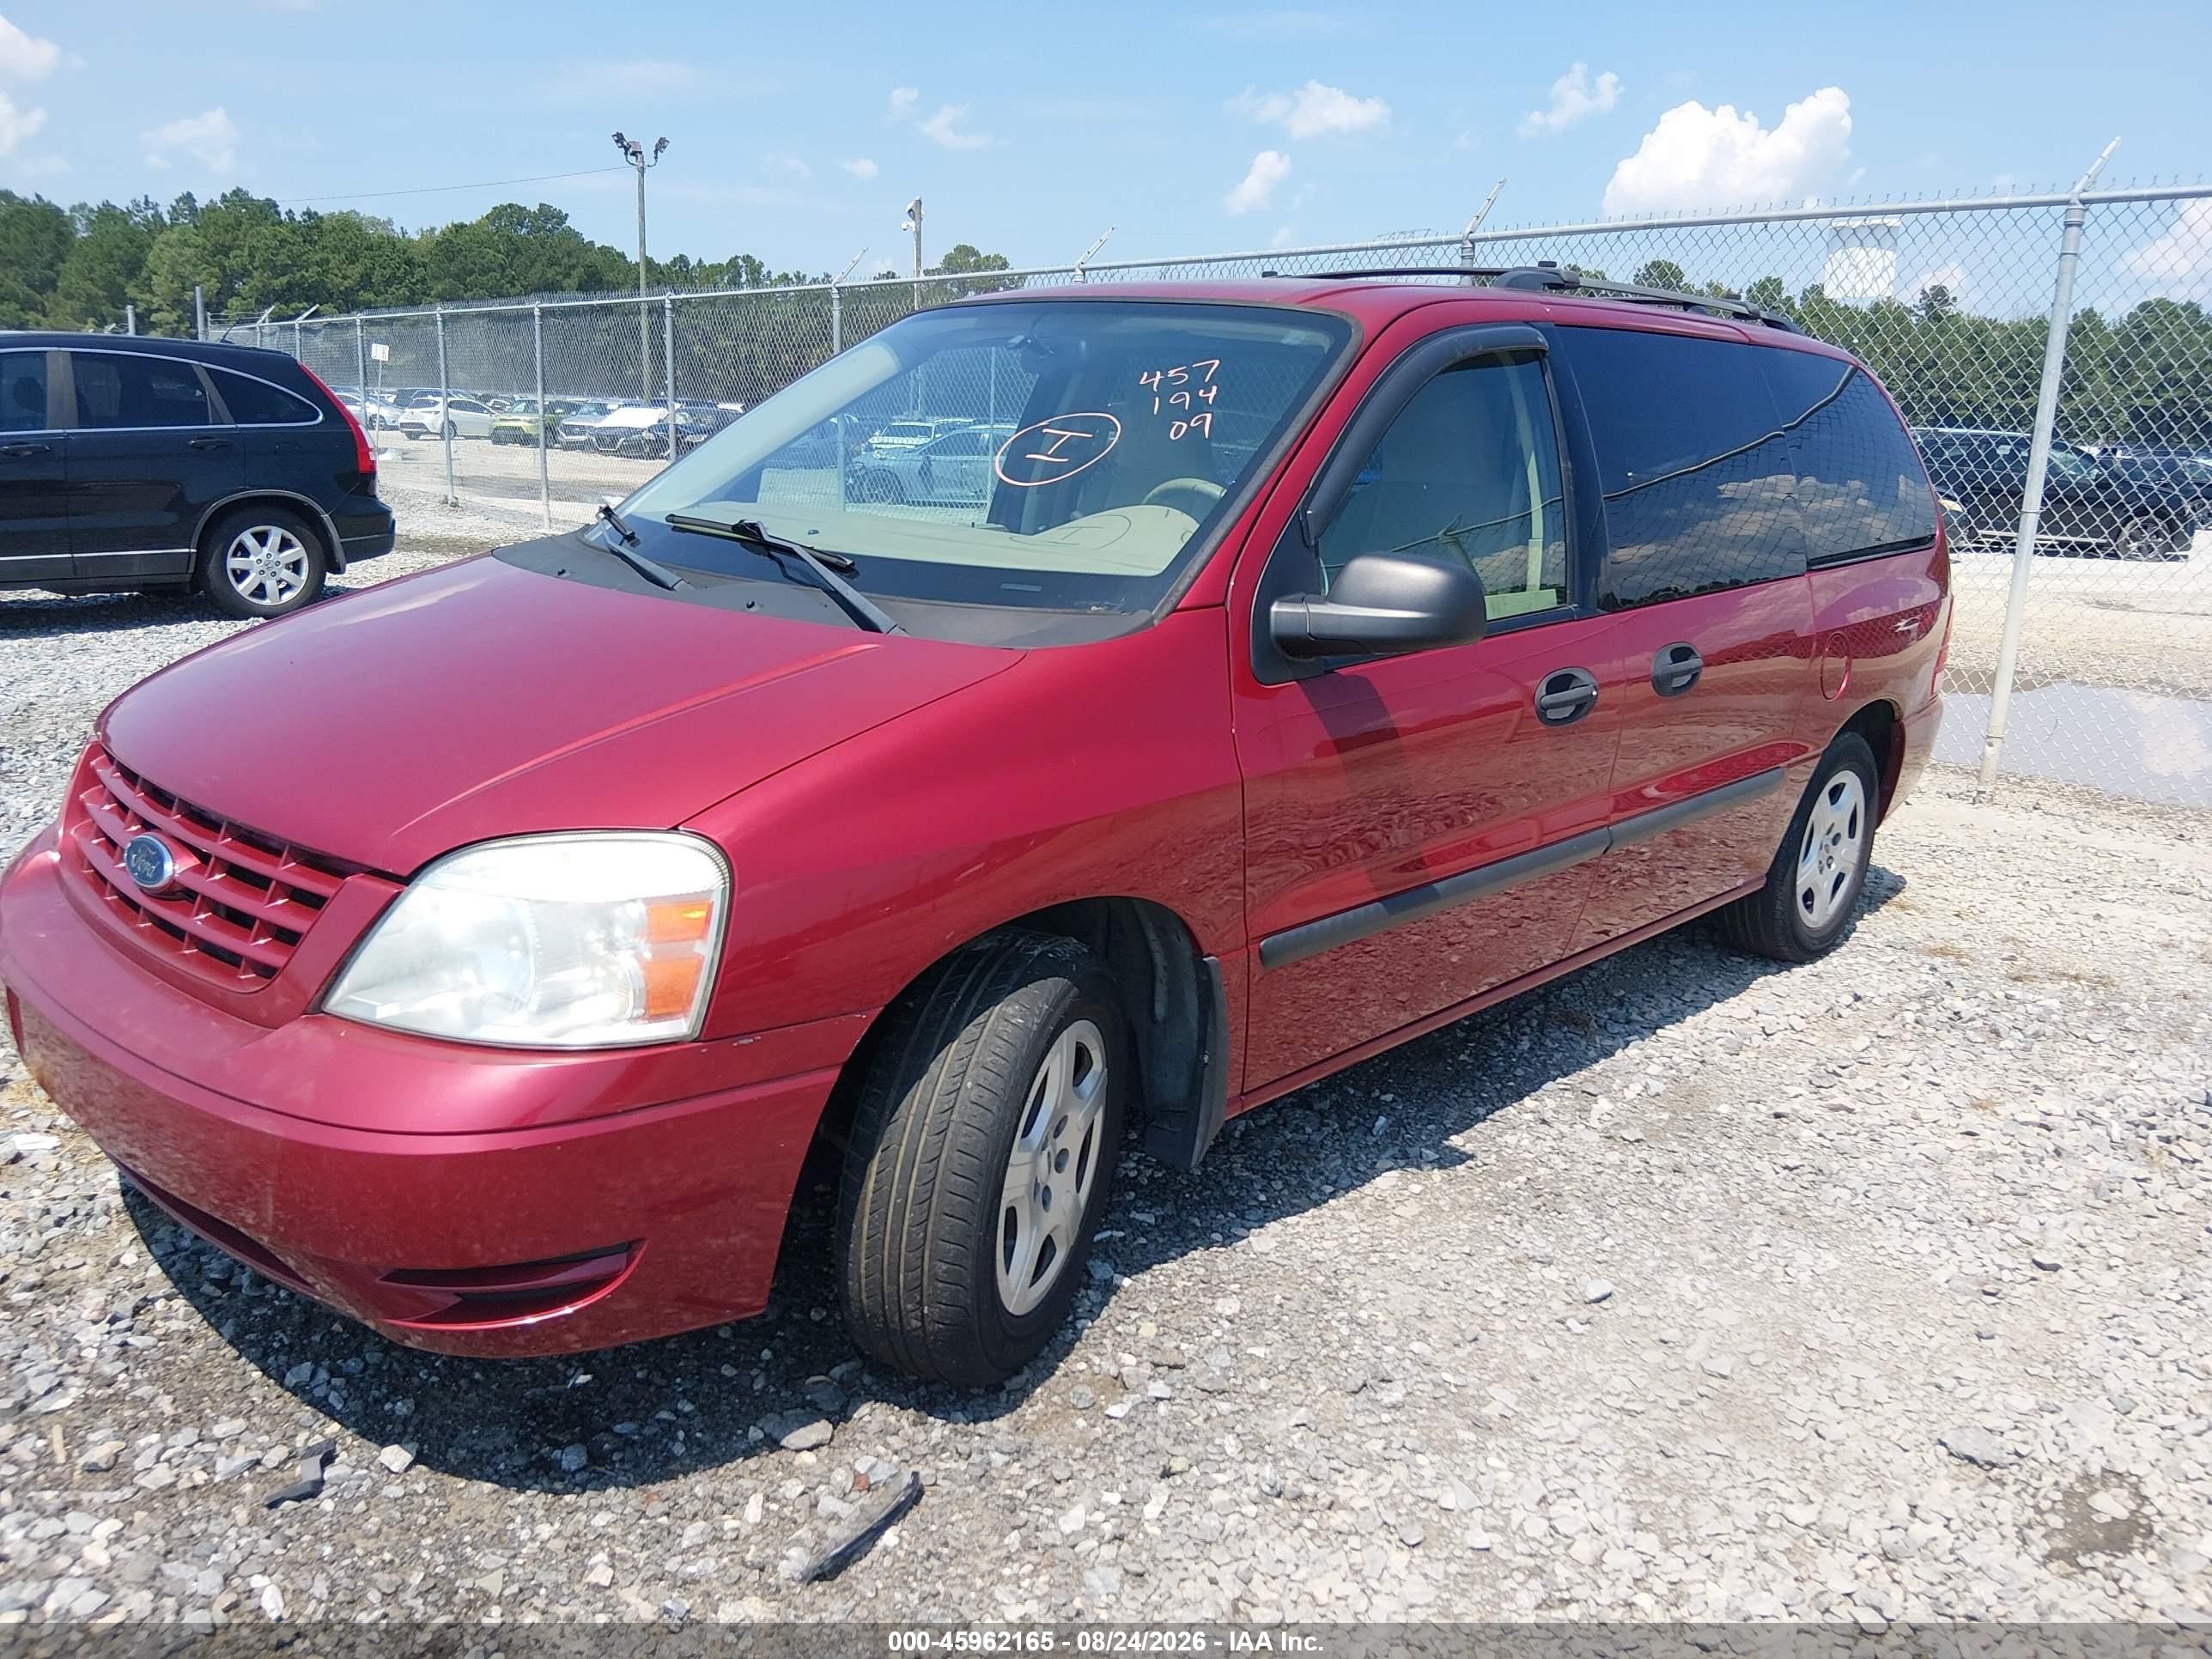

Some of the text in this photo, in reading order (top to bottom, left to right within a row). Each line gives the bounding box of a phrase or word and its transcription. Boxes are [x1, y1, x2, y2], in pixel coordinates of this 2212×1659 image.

[1139, 359, 1221, 392] 457
[1152, 385, 1217, 415] 194
[1170, 412, 1213, 441] 09
